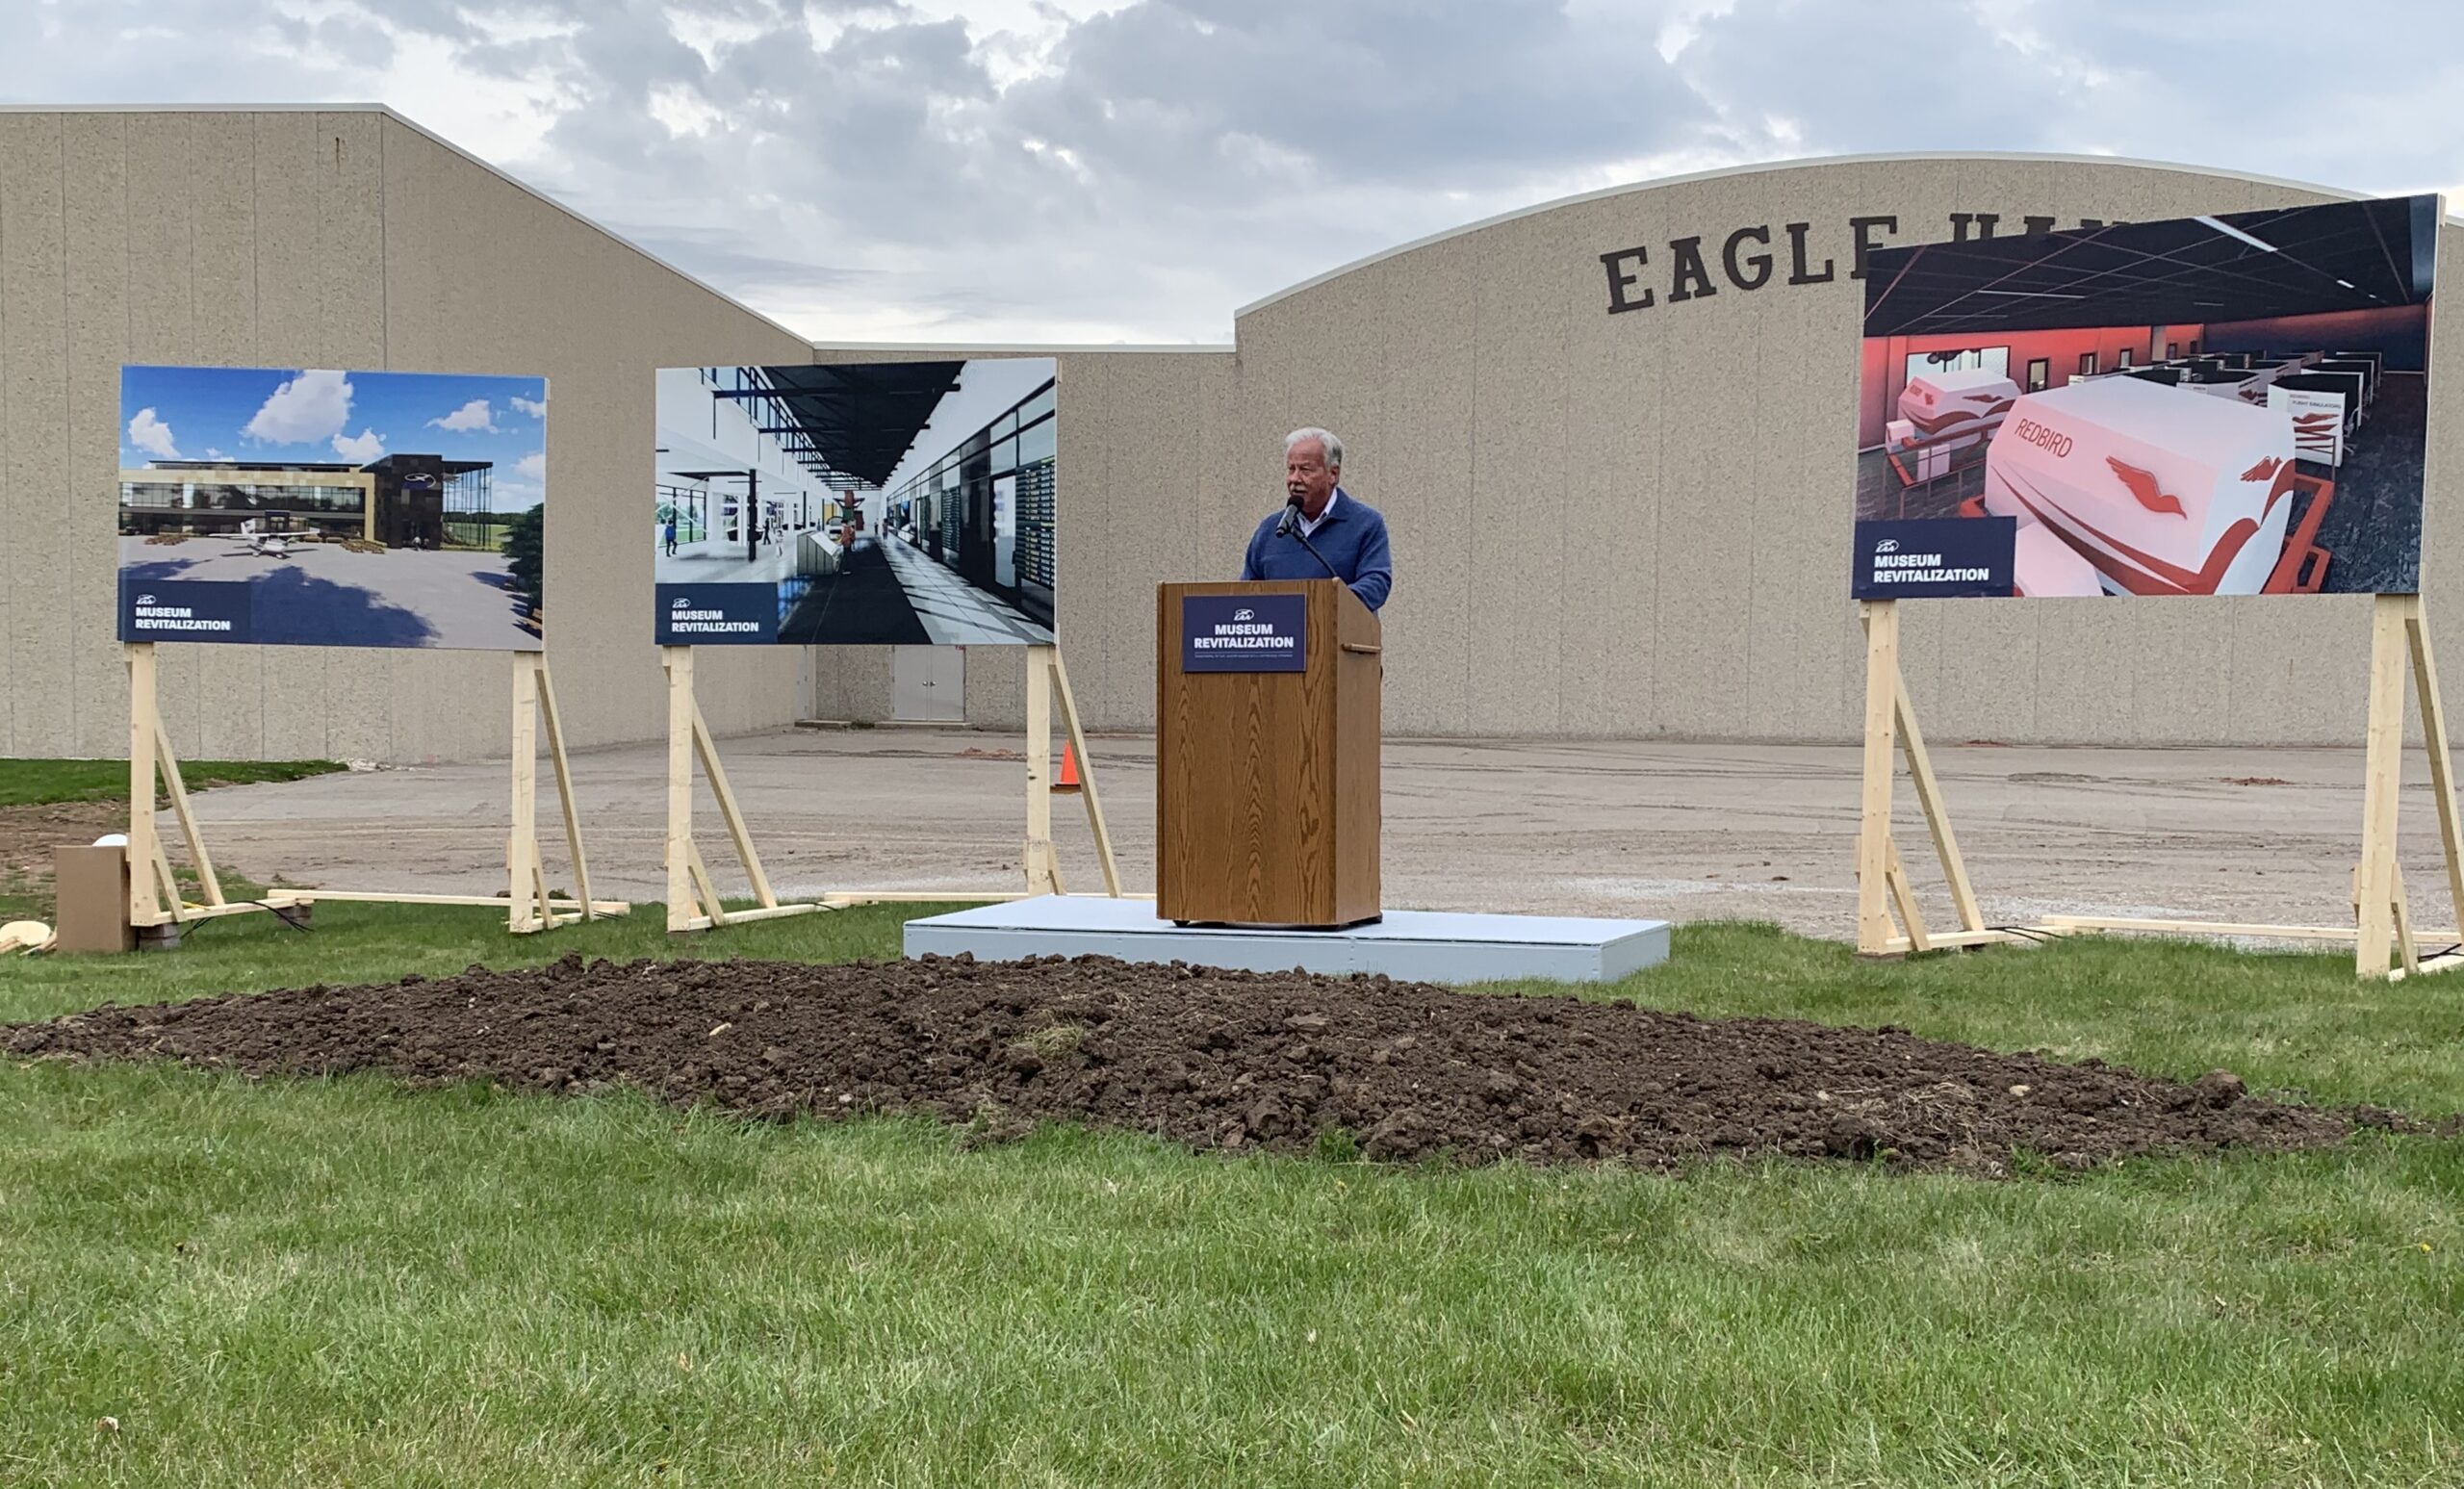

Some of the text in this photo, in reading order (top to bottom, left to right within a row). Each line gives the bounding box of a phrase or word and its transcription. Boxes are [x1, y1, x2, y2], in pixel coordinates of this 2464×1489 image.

[1600, 216, 1897, 315] EAGLE
[2015, 418, 2073, 458] REDBIRD
[1874, 553, 1942, 568] MUSEUM
[1873, 568, 1990, 583] REVITALIZATION
[135, 607, 192, 618] MUSEUM
[671, 610, 723, 621] MUSEUM
[135, 619, 231, 630] REVITALIZATION
[671, 622, 759, 632] REVITALIZATION
[1214, 624, 1273, 635] MUSEUM
[1194, 636, 1295, 649] REVITALIZATION
